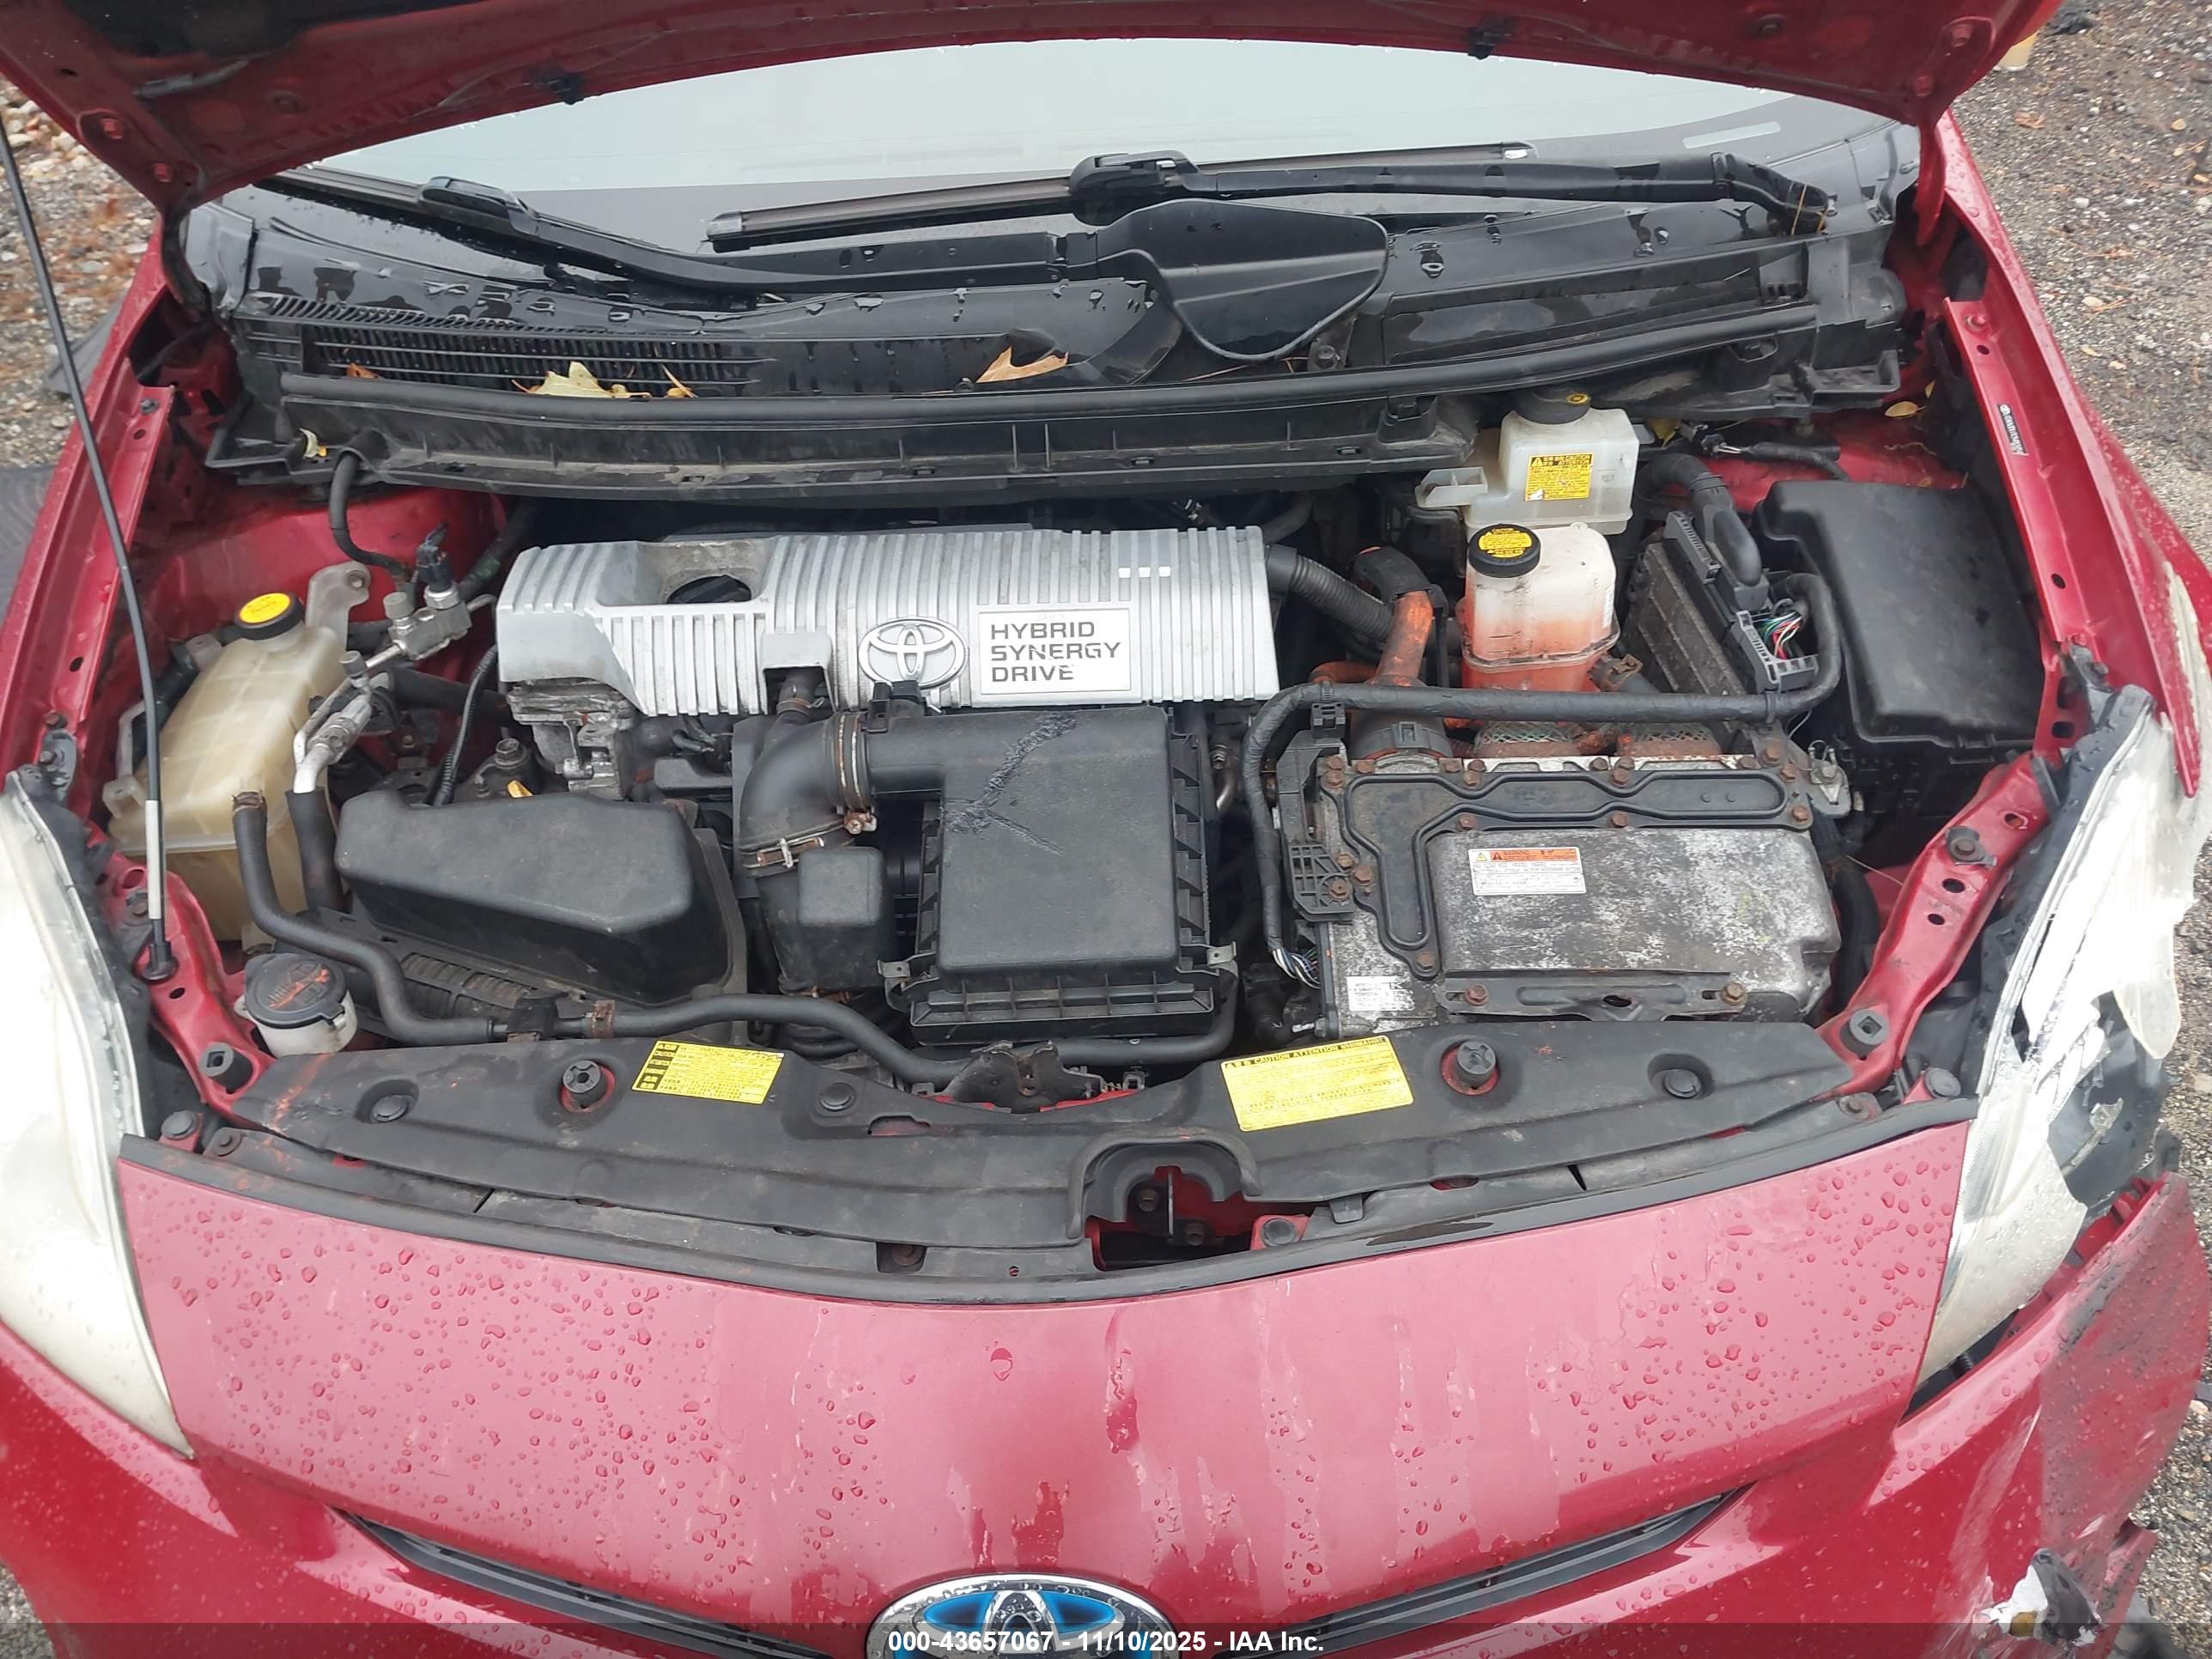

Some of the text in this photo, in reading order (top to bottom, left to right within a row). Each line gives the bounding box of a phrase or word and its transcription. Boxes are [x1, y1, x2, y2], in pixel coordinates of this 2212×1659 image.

[991, 622, 1095, 640] HYBRID
[991, 641, 1121, 661] SYNERGY
[992, 665, 1075, 682] DRIVE
[1254, 1053, 1290, 1064] CAUTION
[1295, 1045, 1339, 1058] ATTENTION
